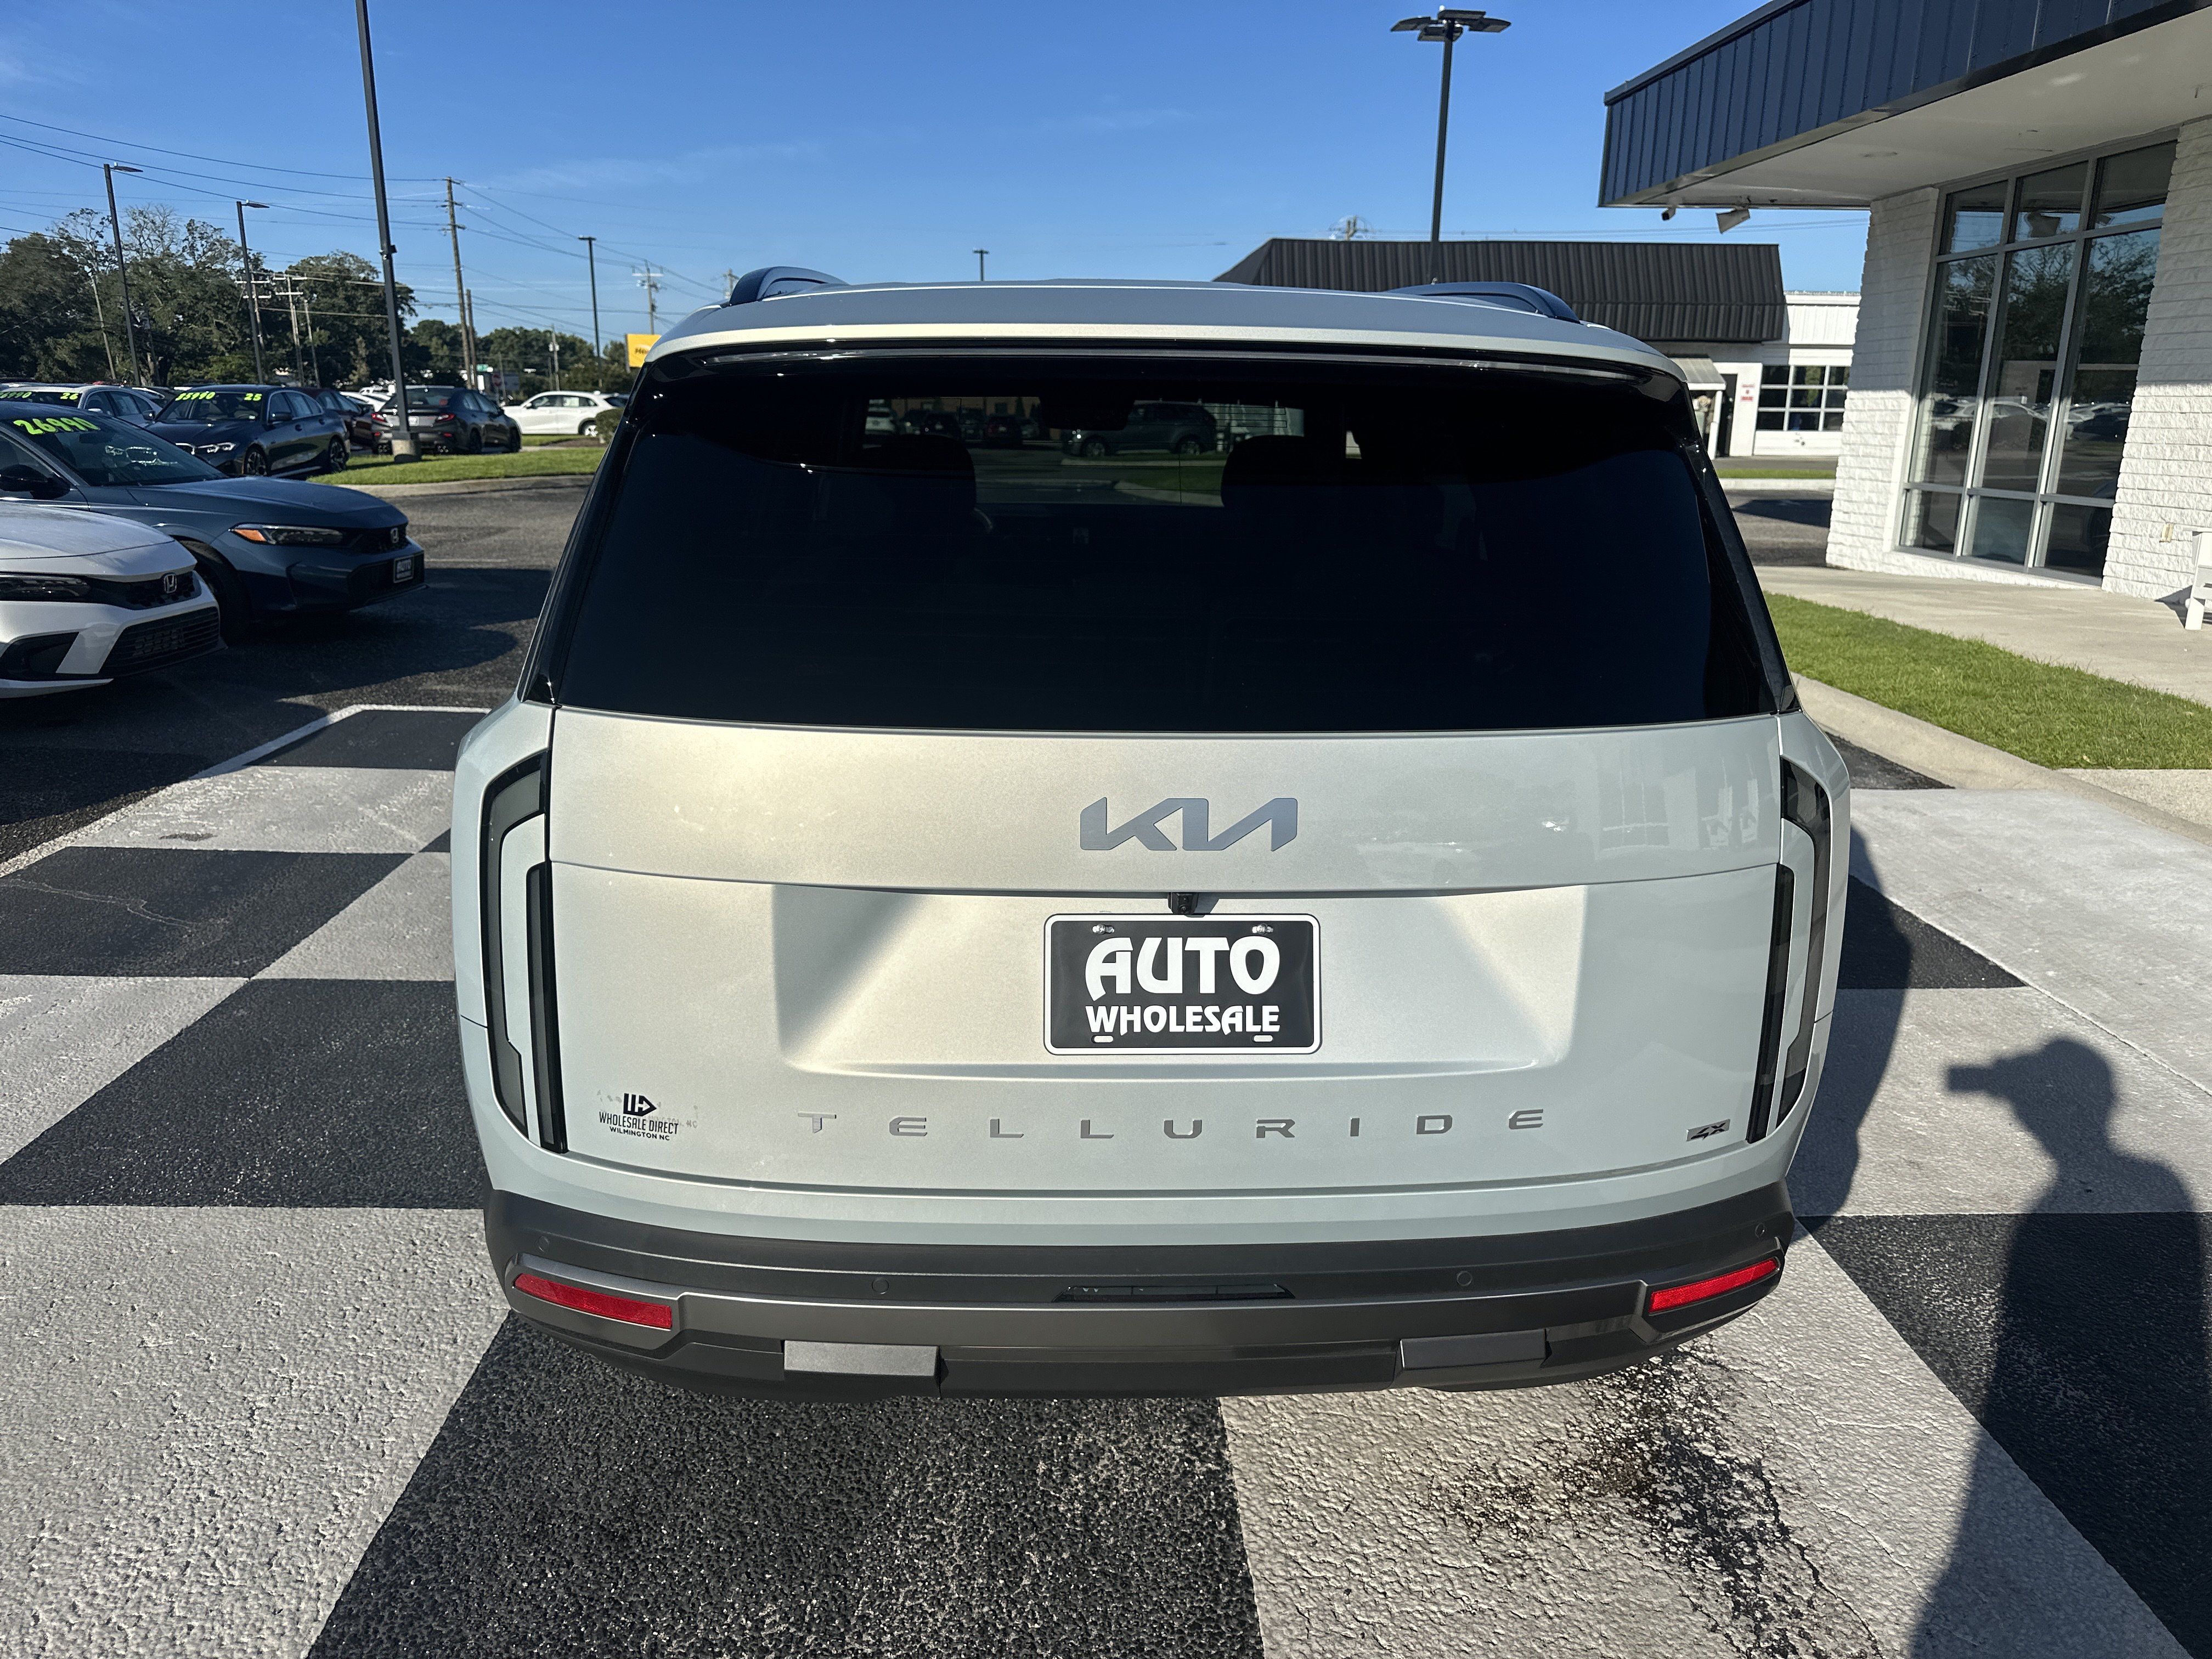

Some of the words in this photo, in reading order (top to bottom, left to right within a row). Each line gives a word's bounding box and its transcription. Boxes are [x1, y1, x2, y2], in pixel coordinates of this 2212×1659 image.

[244, 393, 262, 401] 25
[13, 416, 101, 435] 26990
[1080, 797, 1297, 851] KIA
[1085, 936, 1280, 1001] AUTO
[1085, 1005, 1280, 1035] WHOLESALE
[599, 1111, 646, 1130] WHOLESALE
[649, 1120, 679, 1134] DIRECT
[610, 1126, 657, 1139] WILMINGTON
[797, 1109, 1544, 1138] TELLURIDE
